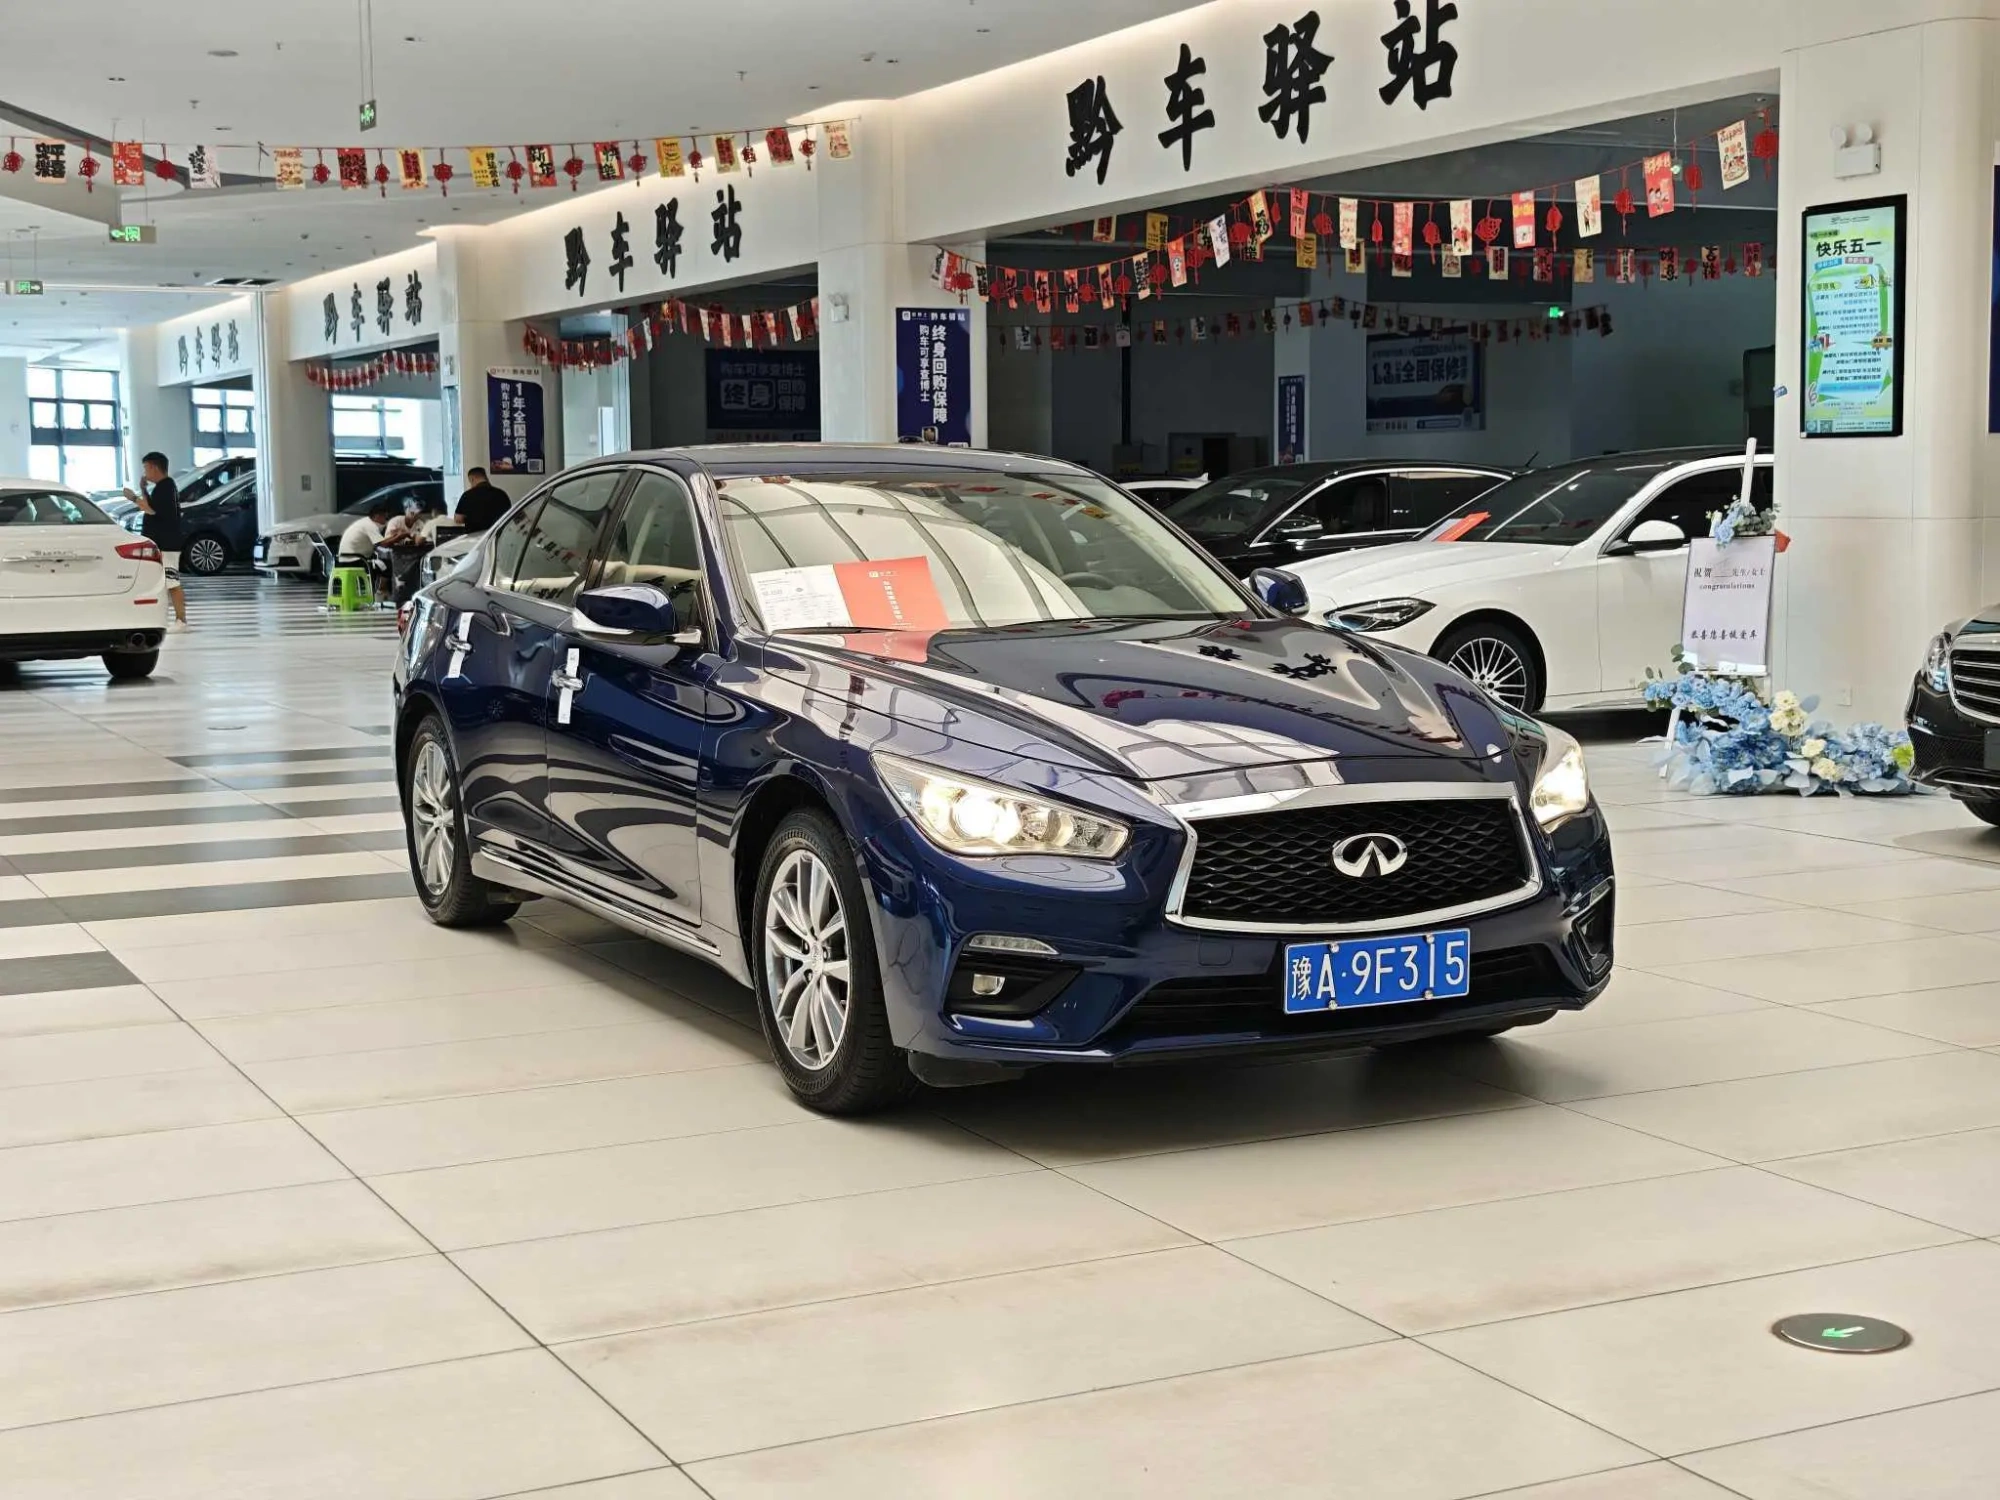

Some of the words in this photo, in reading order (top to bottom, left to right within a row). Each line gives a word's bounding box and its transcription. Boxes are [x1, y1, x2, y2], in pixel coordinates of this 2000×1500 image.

[1066, 0, 1459, 186] 黔车驿站
[564, 183, 742, 297] 黔车驿站
[1816, 237, 1882, 258] 快乐五一
[323, 269, 423, 345] 黔车驿站
[919, 324, 930, 402] 购车可享查博士
[931, 324, 948, 424] 终身回购保障
[512, 382, 528, 465] 1年全国保修
[1291, 939, 1466, 1001] 豫A·9F315
